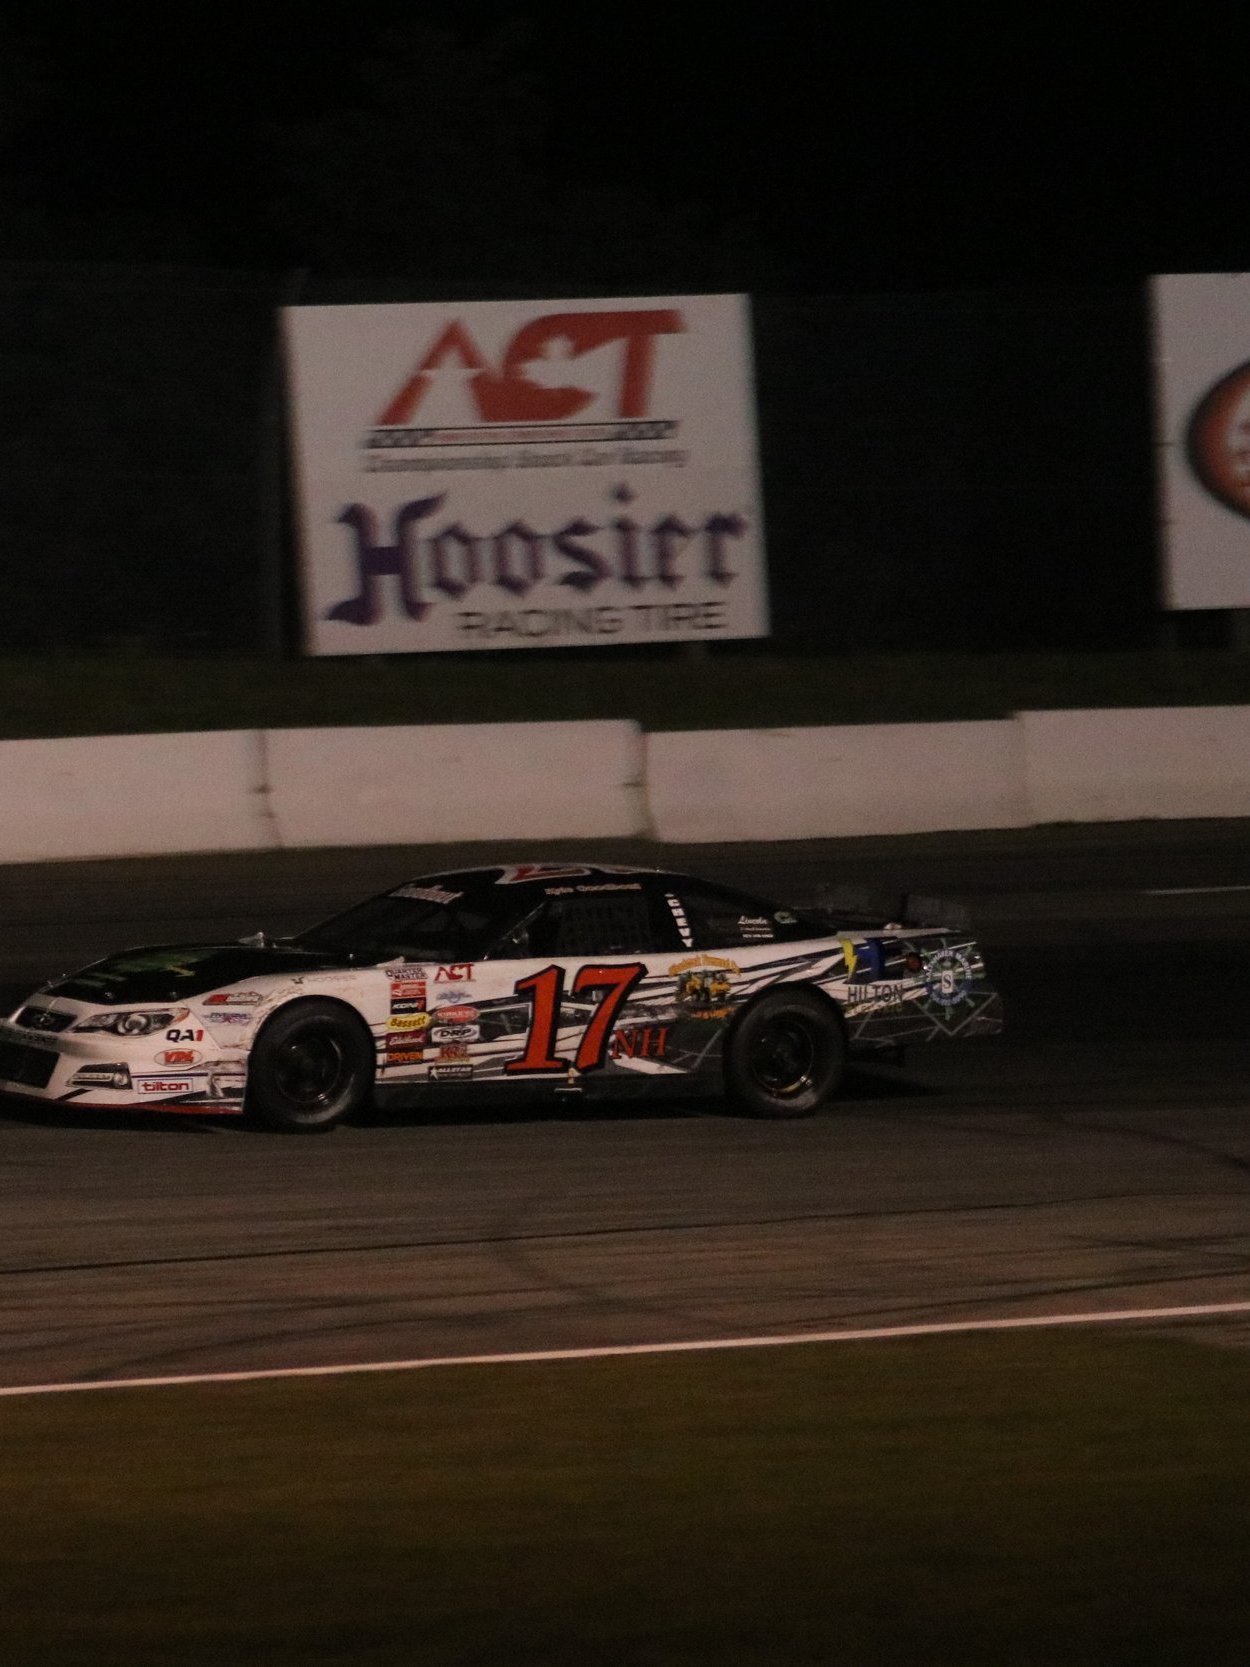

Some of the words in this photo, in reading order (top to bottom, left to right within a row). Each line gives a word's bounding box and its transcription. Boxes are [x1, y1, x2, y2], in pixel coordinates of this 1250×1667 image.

[375, 308, 687, 425] ACT
[323, 484, 747, 625] Hoosier
[453, 604, 624, 639] RACING
[630, 601, 728, 631] TIRE
[434, 963, 475, 981] ACT
[847, 983, 904, 1003] HILTON
[390, 1015, 426, 1028] Bassett
[503, 962, 648, 1074] 17
[166, 1029, 204, 1043] QA1
[440, 1028, 471, 1038] DRP
[609, 1025, 668, 1060] NH
[388, 1052, 423, 1062] DRIVEN
[141, 1081, 190, 1092] tilton
